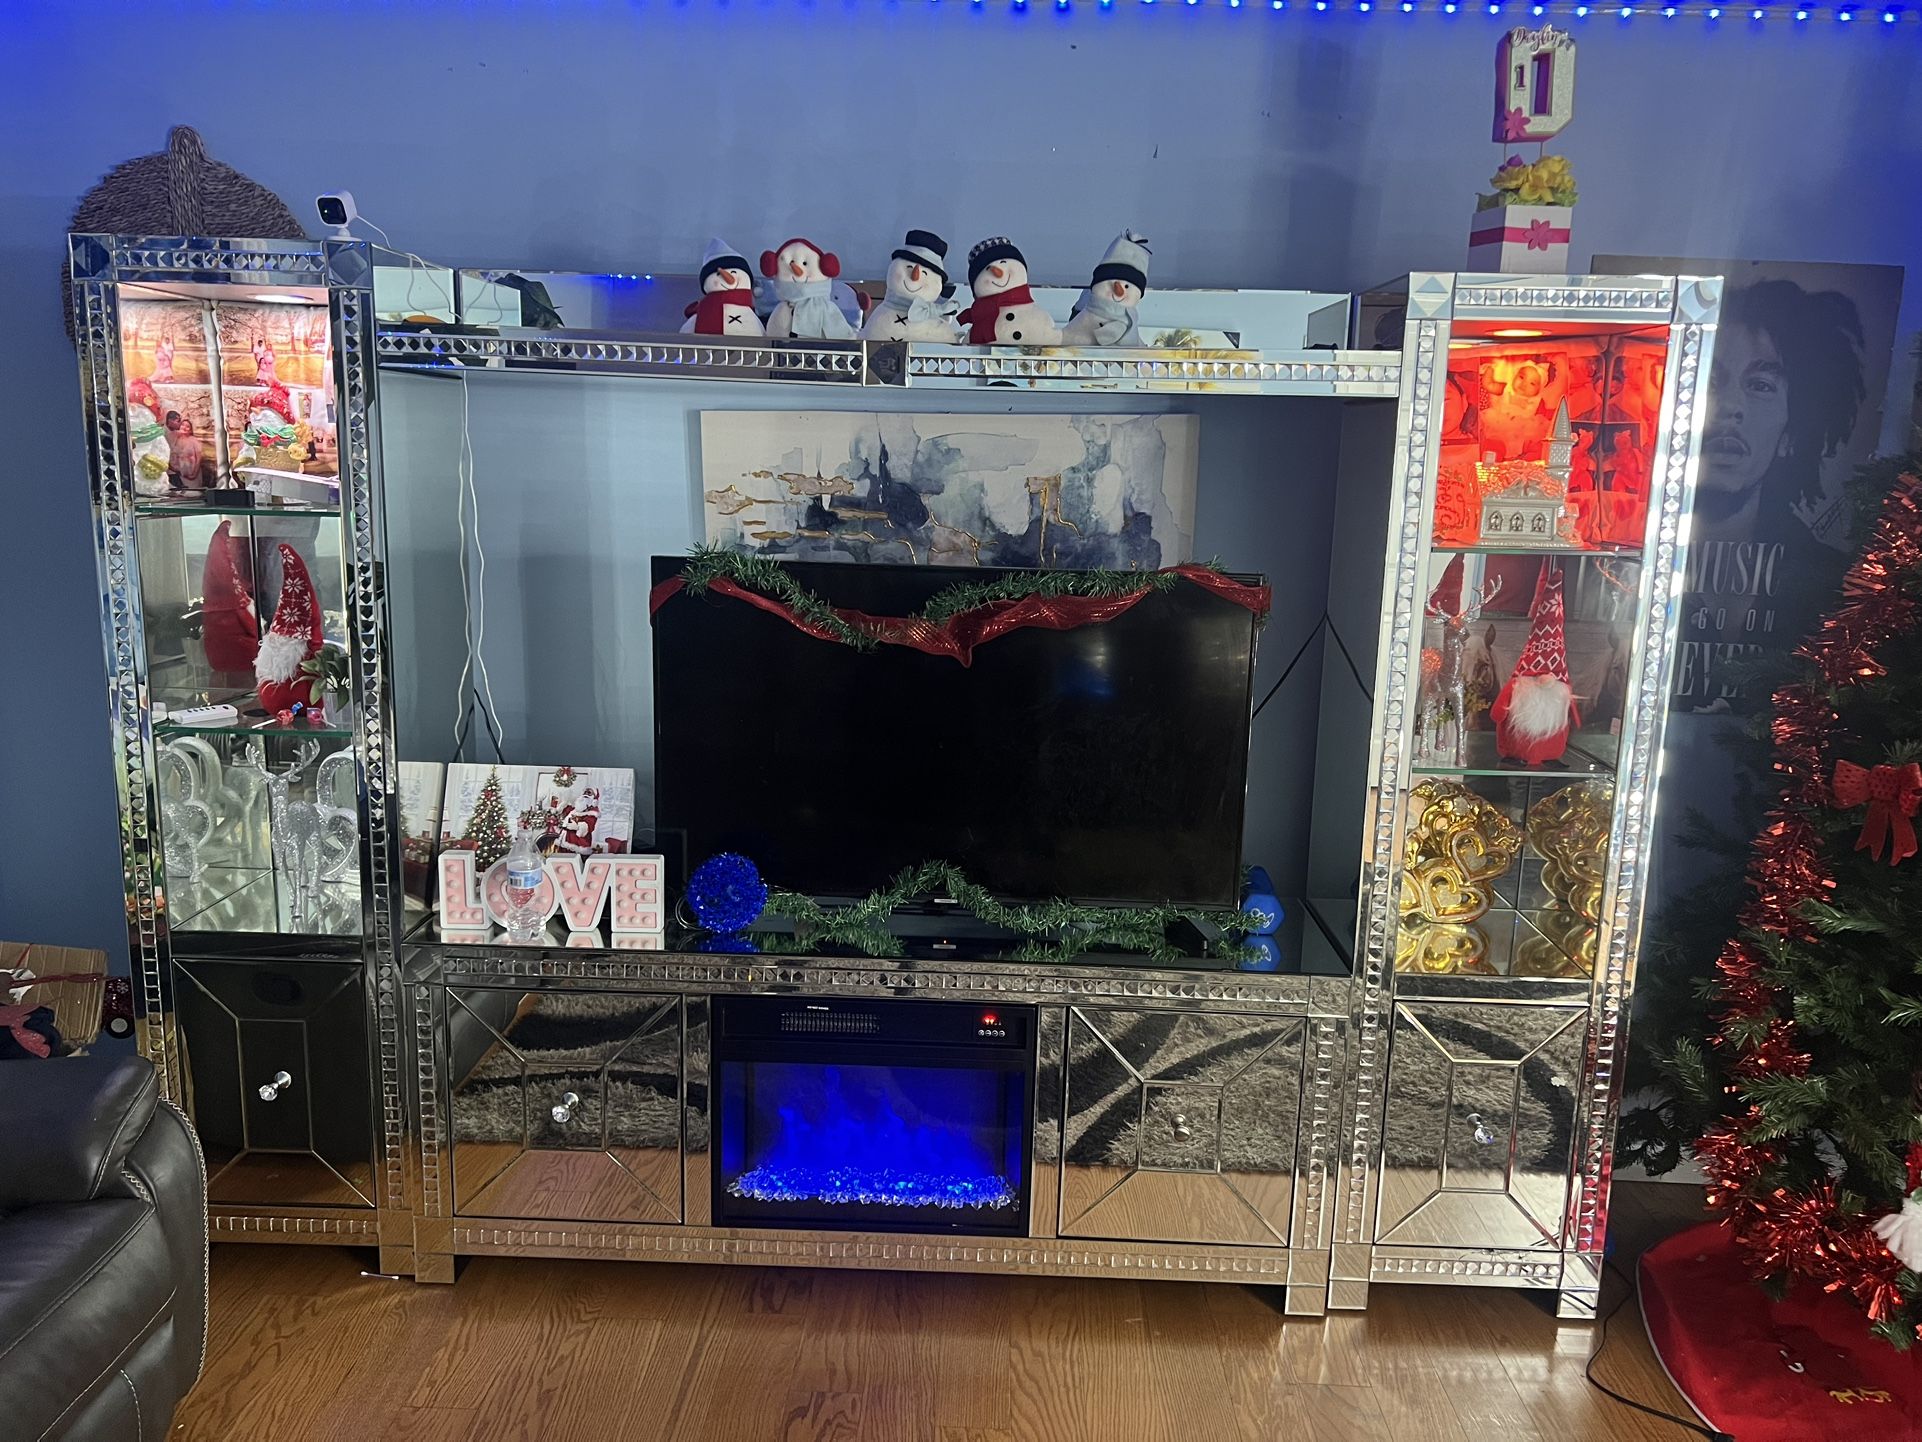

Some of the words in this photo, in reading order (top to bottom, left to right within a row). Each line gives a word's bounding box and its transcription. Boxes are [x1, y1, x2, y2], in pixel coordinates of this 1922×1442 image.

[1685, 540, 1785, 597] MUSIC
[1697, 606, 1727, 631] GO
[1745, 608, 1776, 633] ON
[1675, 641, 1764, 698] EVE
[438, 850, 665, 933] LOVE
